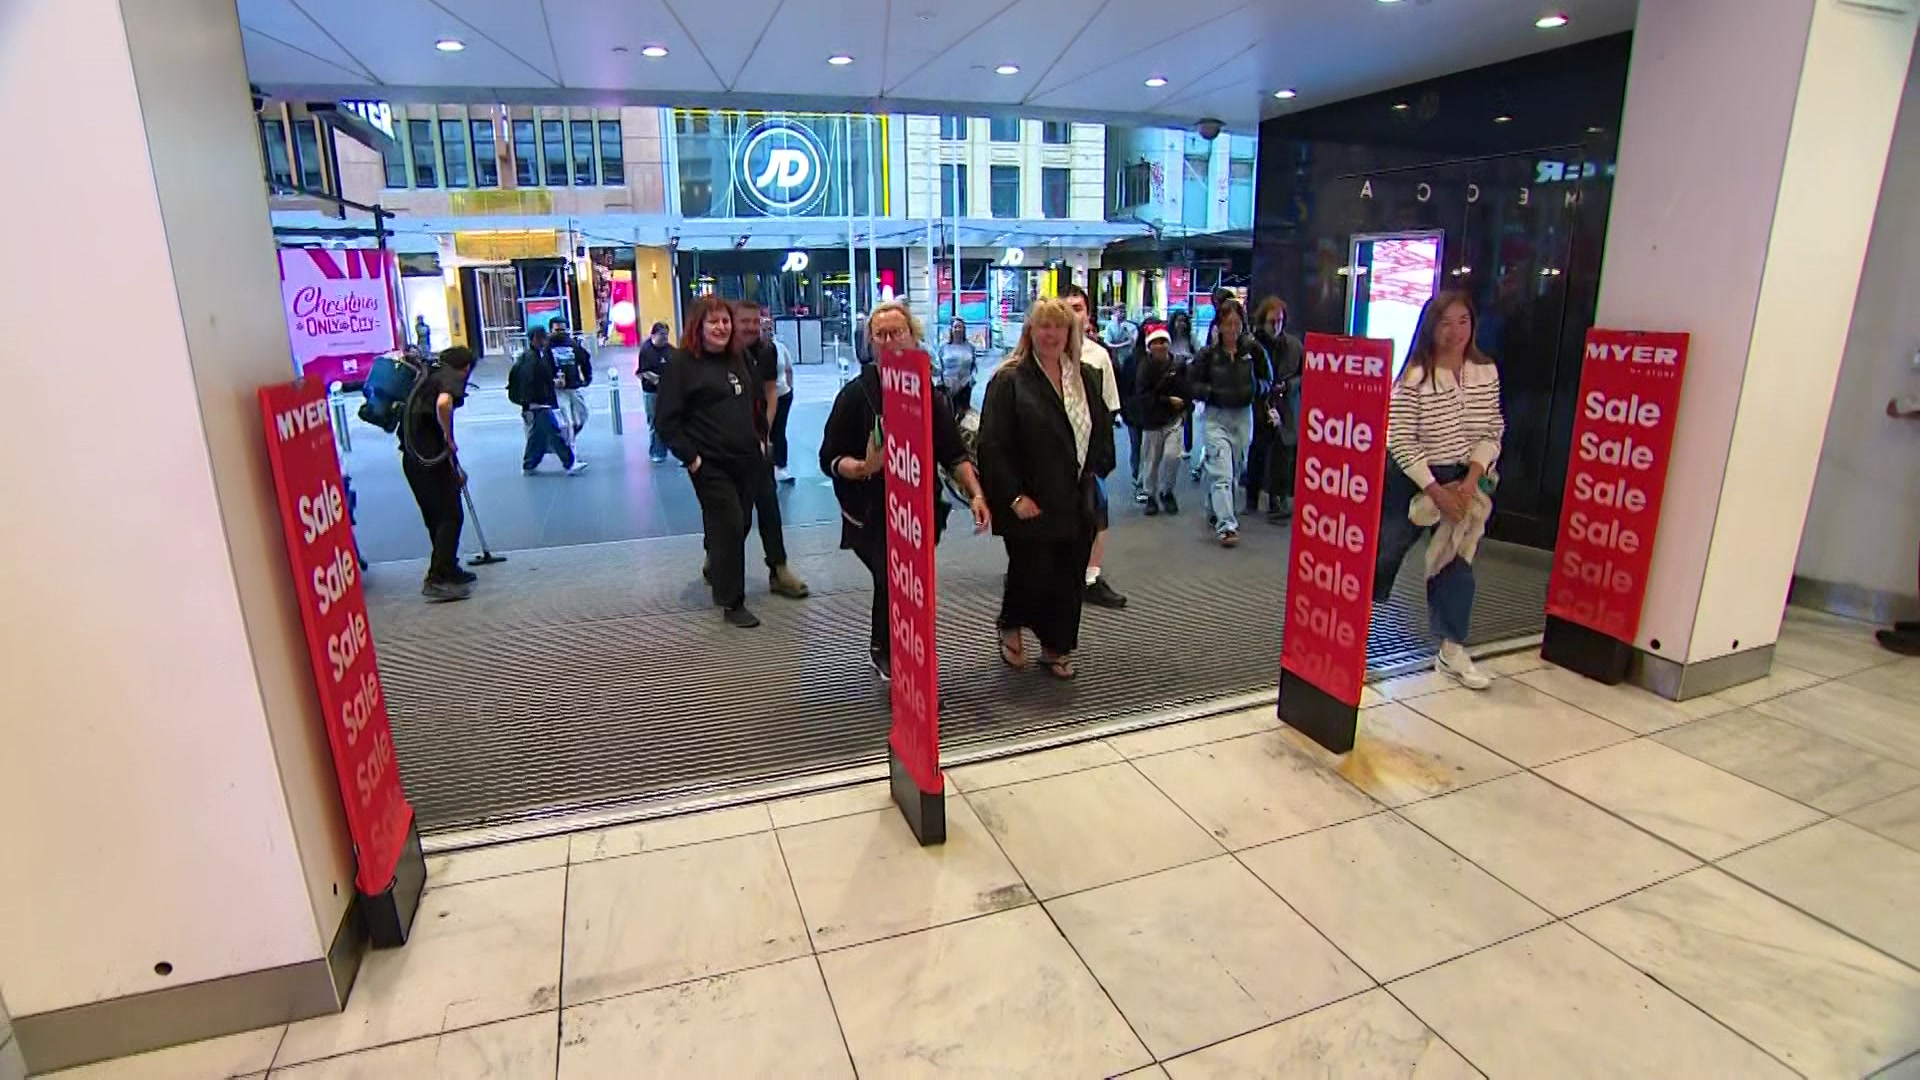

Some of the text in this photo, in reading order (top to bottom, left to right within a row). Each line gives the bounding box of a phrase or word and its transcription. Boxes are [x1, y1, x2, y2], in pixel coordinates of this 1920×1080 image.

[756, 149, 810, 188] JD
[781, 251, 809, 273] JD
[1000, 247, 1024, 267] JD
[1305, 351, 1384, 378] MYER
[1586, 342, 1678, 365] MYER
[882, 366, 921, 398] MYER
[275, 399, 329, 442] MYER
[1307, 407, 1373, 452] Sale
[1584, 390, 1661, 428] Sale
[887, 433, 921, 488] Sale
[1578, 431, 1654, 471] Sale
[1304, 456, 1369, 503] Sale
[1573, 472, 1647, 512] Sale
[299, 479, 343, 544] Sale
[889, 492, 922, 550] Sale
[1301, 503, 1365, 554] Sale
[1568, 511, 1640, 554] Sale
[313, 546, 356, 615] Sale
[891, 547, 924, 609] Sale
[1298, 550, 1361, 602] Sale
[1562, 551, 1633, 594] Sale
[892, 601, 925, 668] Sale
[1295, 593, 1355, 647] Sale
[327, 611, 367, 684] Sale
[341, 671, 378, 747] Sale
[893, 654, 926, 721] Sale
[356, 729, 391, 808] Sale
